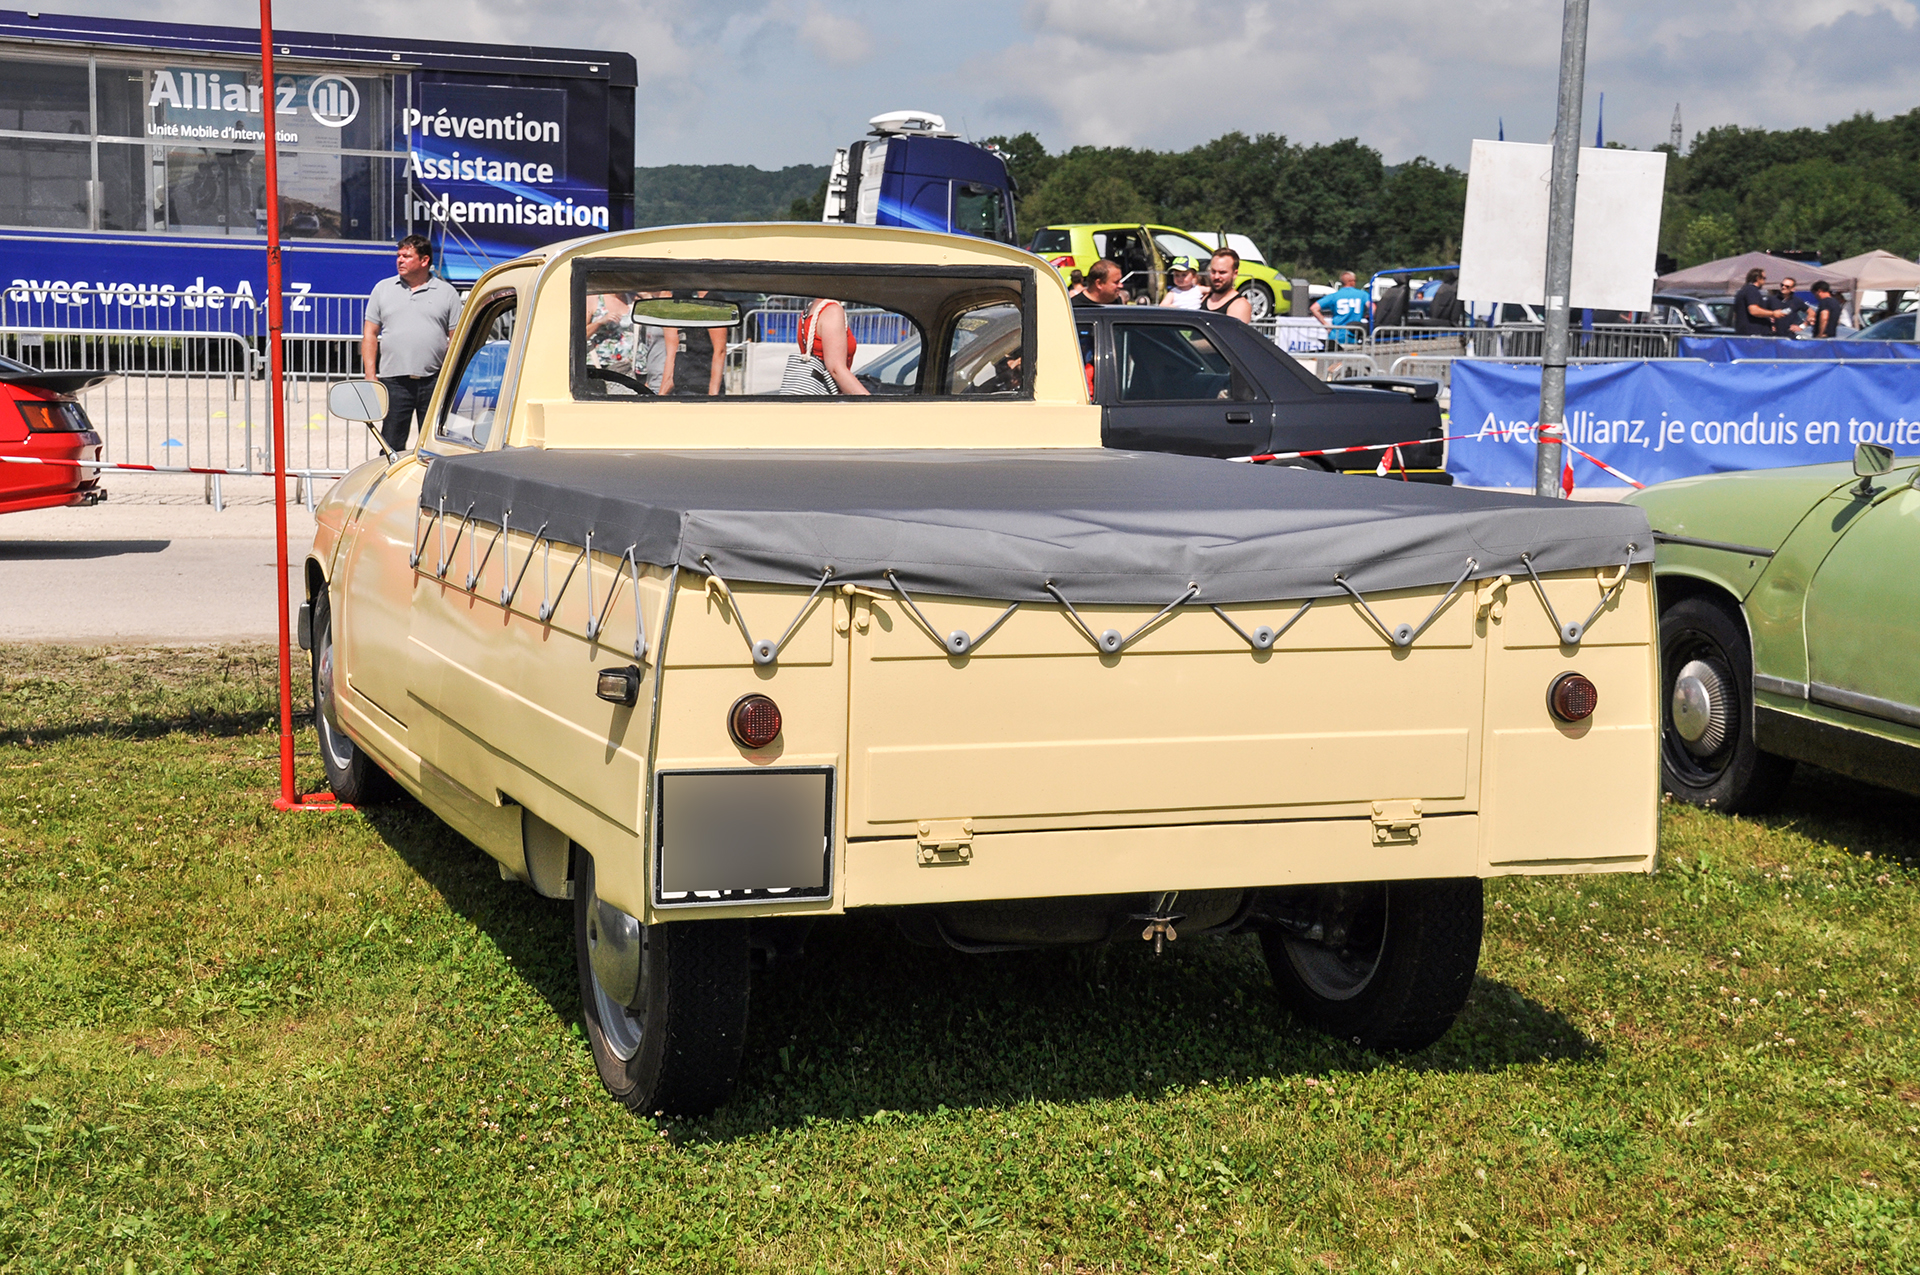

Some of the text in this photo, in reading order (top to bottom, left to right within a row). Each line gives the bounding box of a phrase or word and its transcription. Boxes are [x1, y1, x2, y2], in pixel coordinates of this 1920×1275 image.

[147, 123, 179, 137] Unité
[180, 125, 219, 139] Mobile
[221, 126, 299, 143] d'Intervtion
[402, 107, 560, 142] Prévention
[402, 151, 554, 183] Assistance
[404, 192, 609, 227] Indemnisation
[10, 278, 90, 305] avec
[96, 281, 177, 308] vous
[184, 276, 224, 309] de
[232, 280, 255, 310] A
[289, 282, 312, 312] Z
[1336, 297, 1361, 316] 54
[1653, 411, 1685, 453] je
[1694, 412, 1798, 445] conduis
[1804, 420, 1841, 445] en
[1847, 417, 1920, 445] toute
